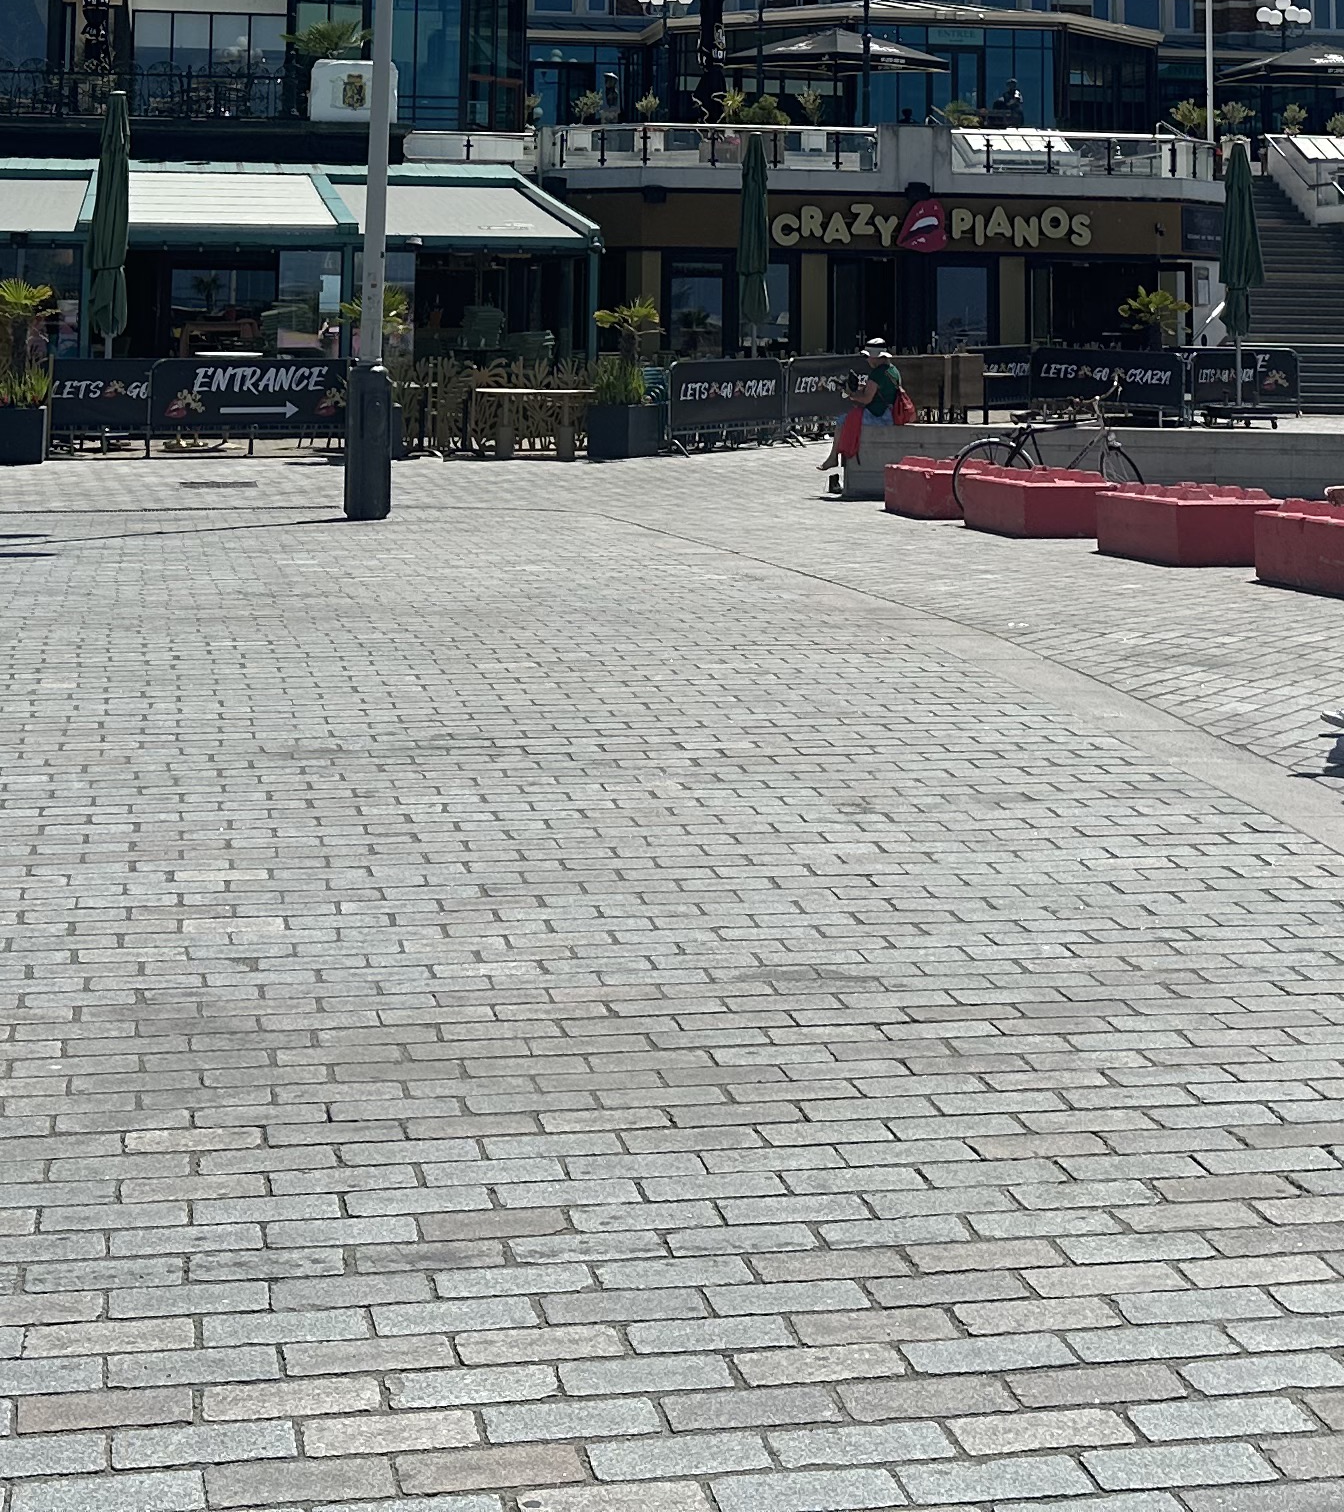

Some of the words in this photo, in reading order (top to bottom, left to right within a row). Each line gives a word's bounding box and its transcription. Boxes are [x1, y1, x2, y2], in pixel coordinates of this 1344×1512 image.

[771, 203, 898, 247] CRAZY
[951, 206, 1092, 248] PIANOS
[193, 366, 330, 396] ENTRANCE
[794, 376, 819, 394] LETS
[1040, 362, 1078, 379] LETS
[1092, 367, 1110, 381] GO
[1125, 367, 1172, 386] CRAZY!
[1198, 368, 1216, 384] LETS
[680, 381, 709, 401] LETS
[720, 383, 733, 399] GO
[744, 379, 776, 398] CRAZY!
